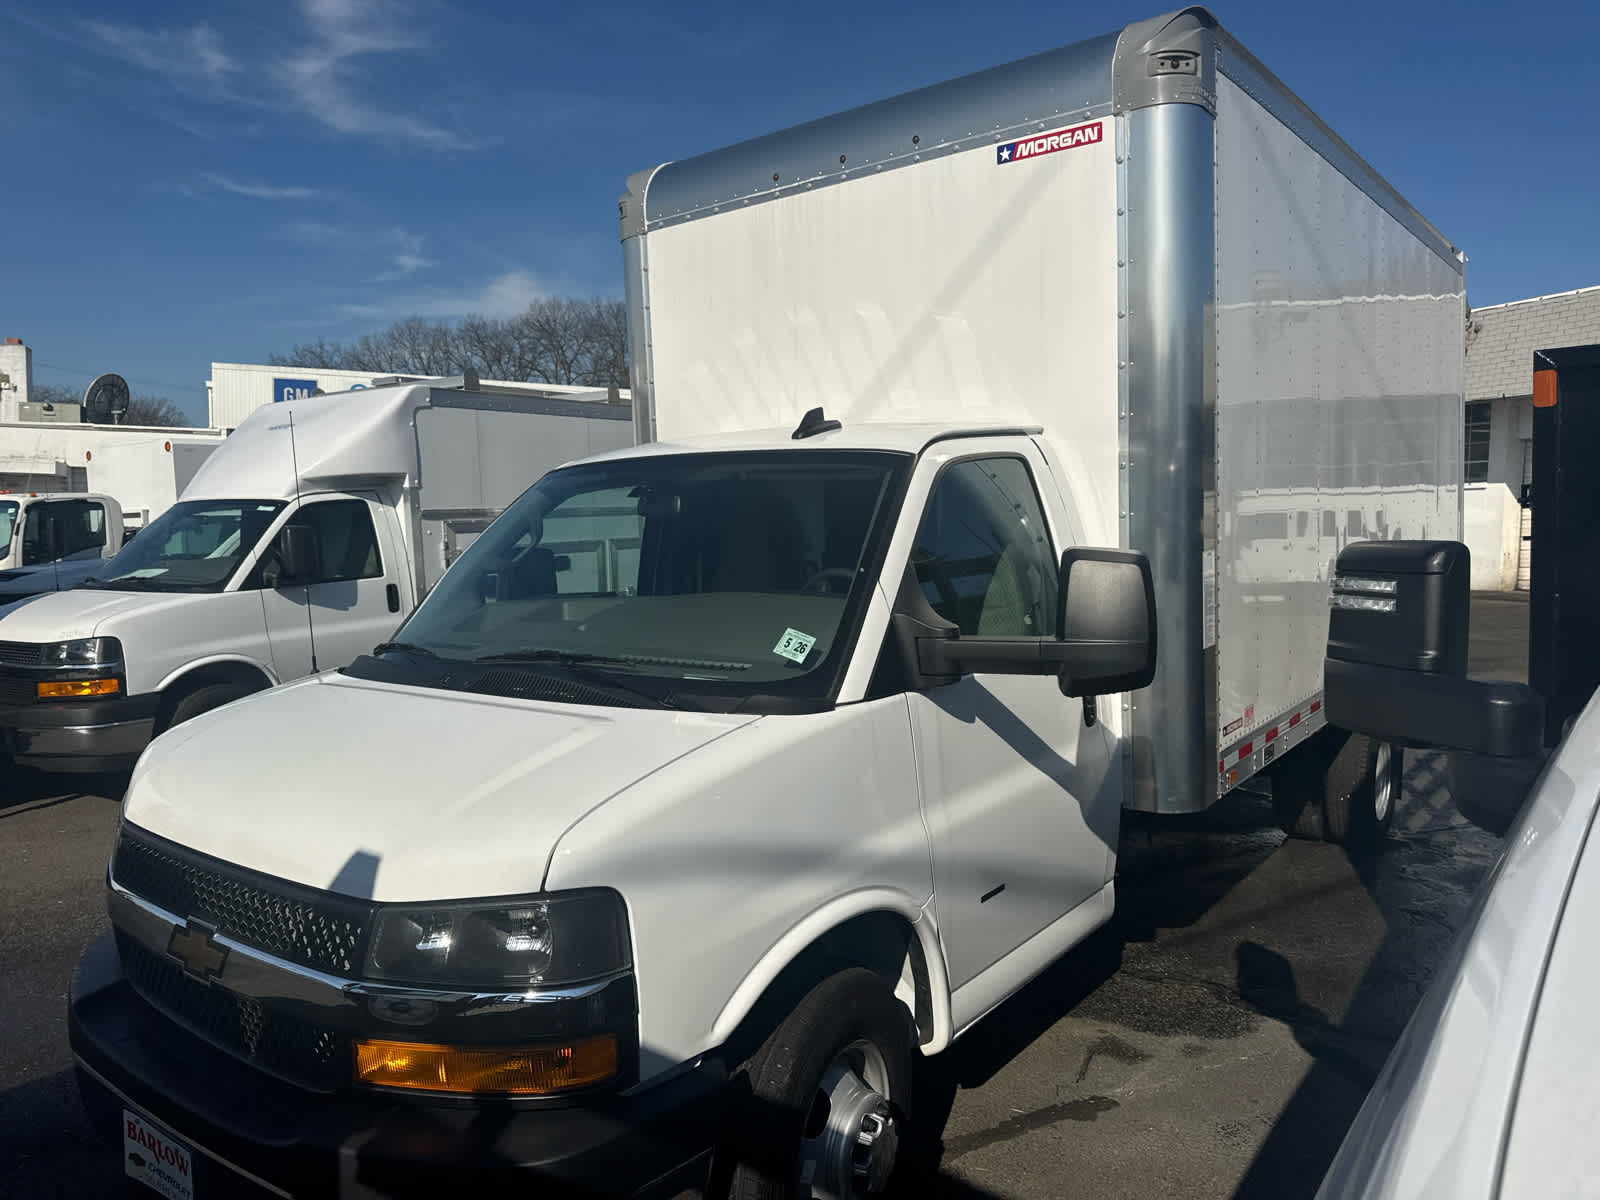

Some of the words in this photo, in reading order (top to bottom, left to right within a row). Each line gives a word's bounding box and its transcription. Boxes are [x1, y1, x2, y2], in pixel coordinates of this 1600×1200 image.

[1015, 126, 1101, 158] MORGAN
[783, 637, 793, 648] 5
[793, 641, 808, 654] 26
[127, 1120, 189, 1176] BARLOW
